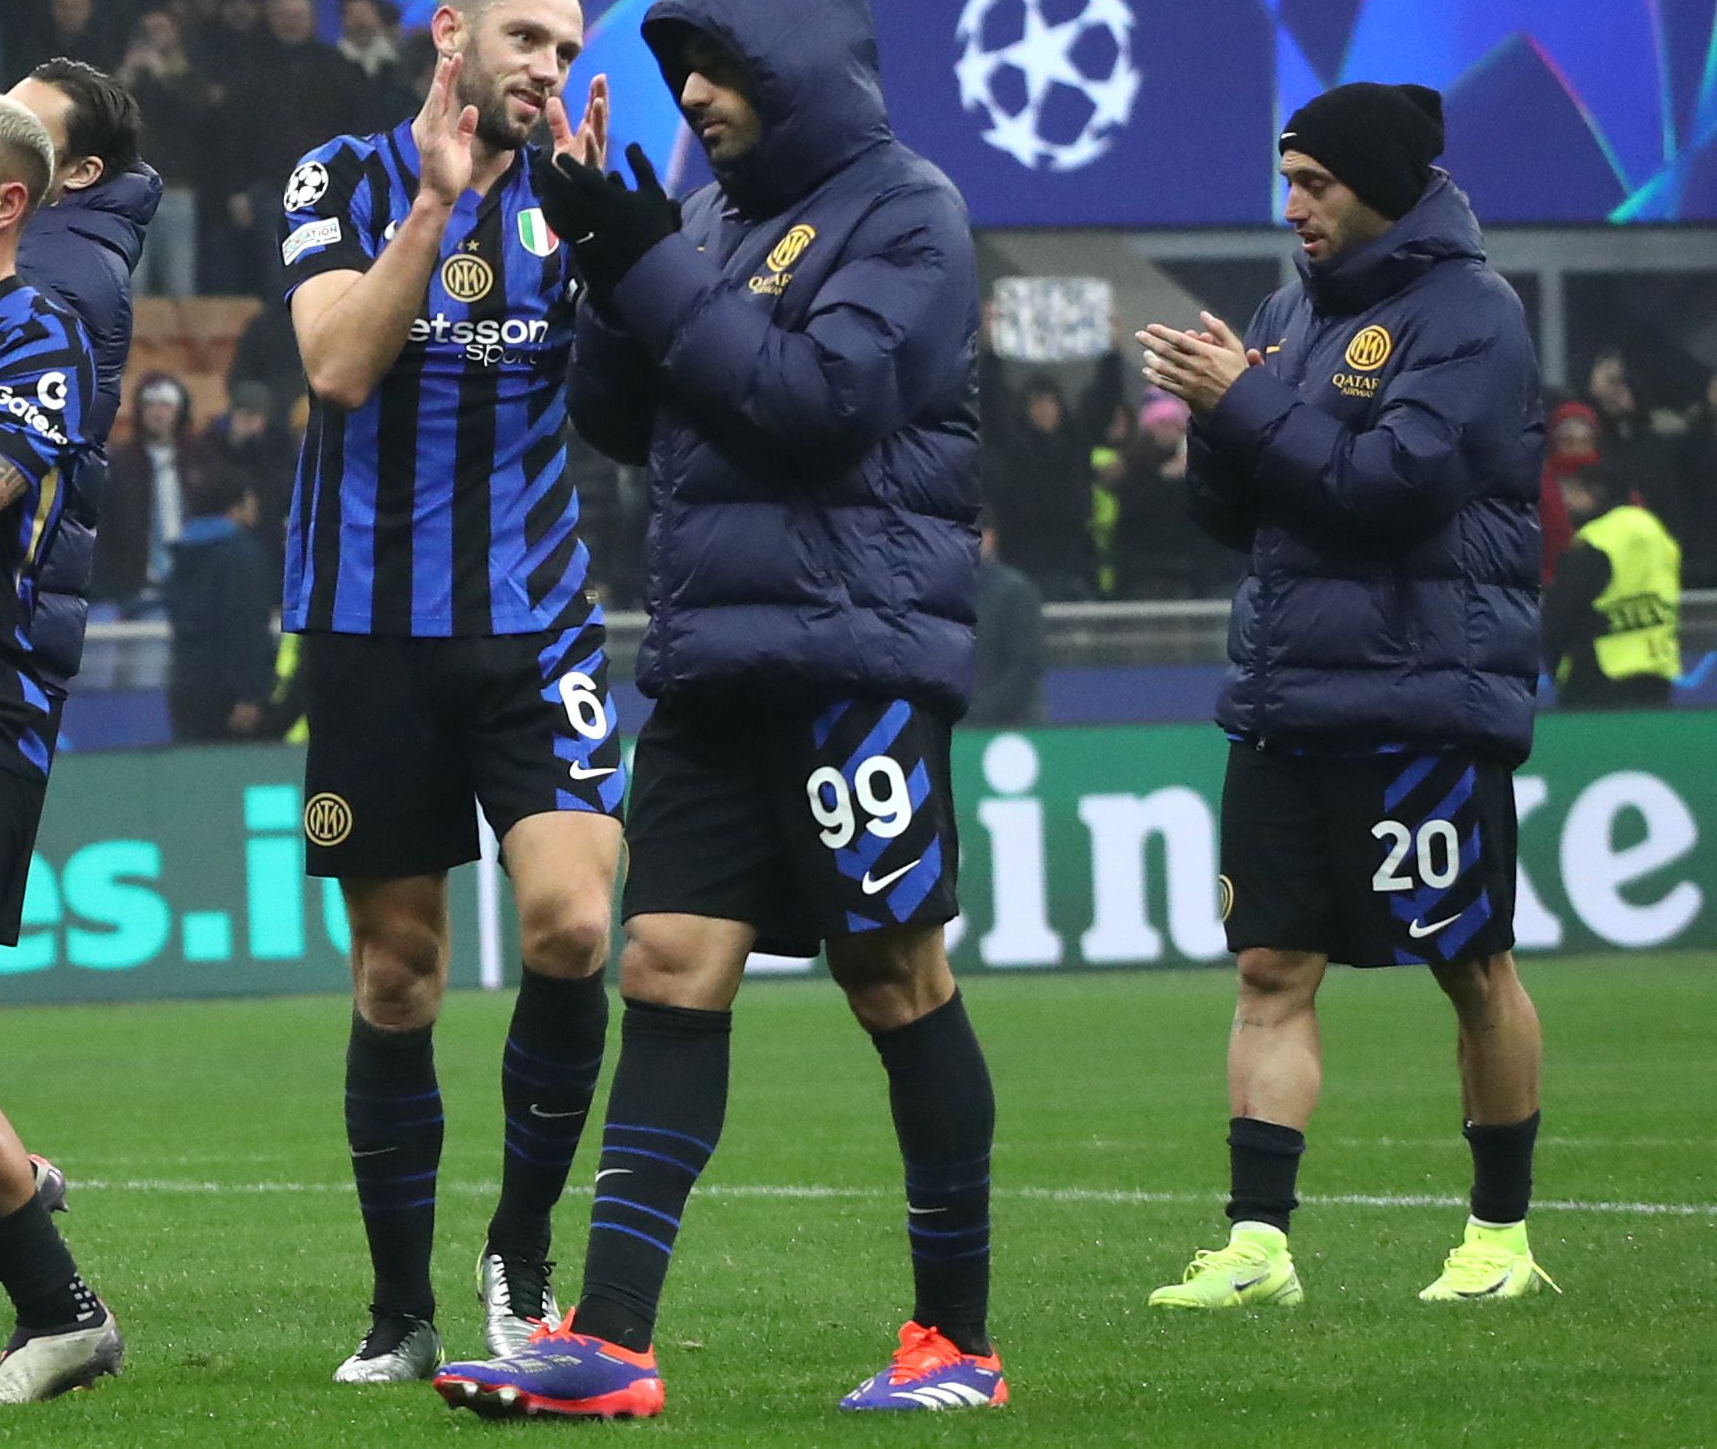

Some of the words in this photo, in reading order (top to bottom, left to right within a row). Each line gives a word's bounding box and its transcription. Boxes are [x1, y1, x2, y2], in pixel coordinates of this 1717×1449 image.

[407, 312, 550, 343] etsson
[559, 671, 608, 741] 6
[806, 755, 913, 850] 99
[1371, 819, 1459, 892] 20
